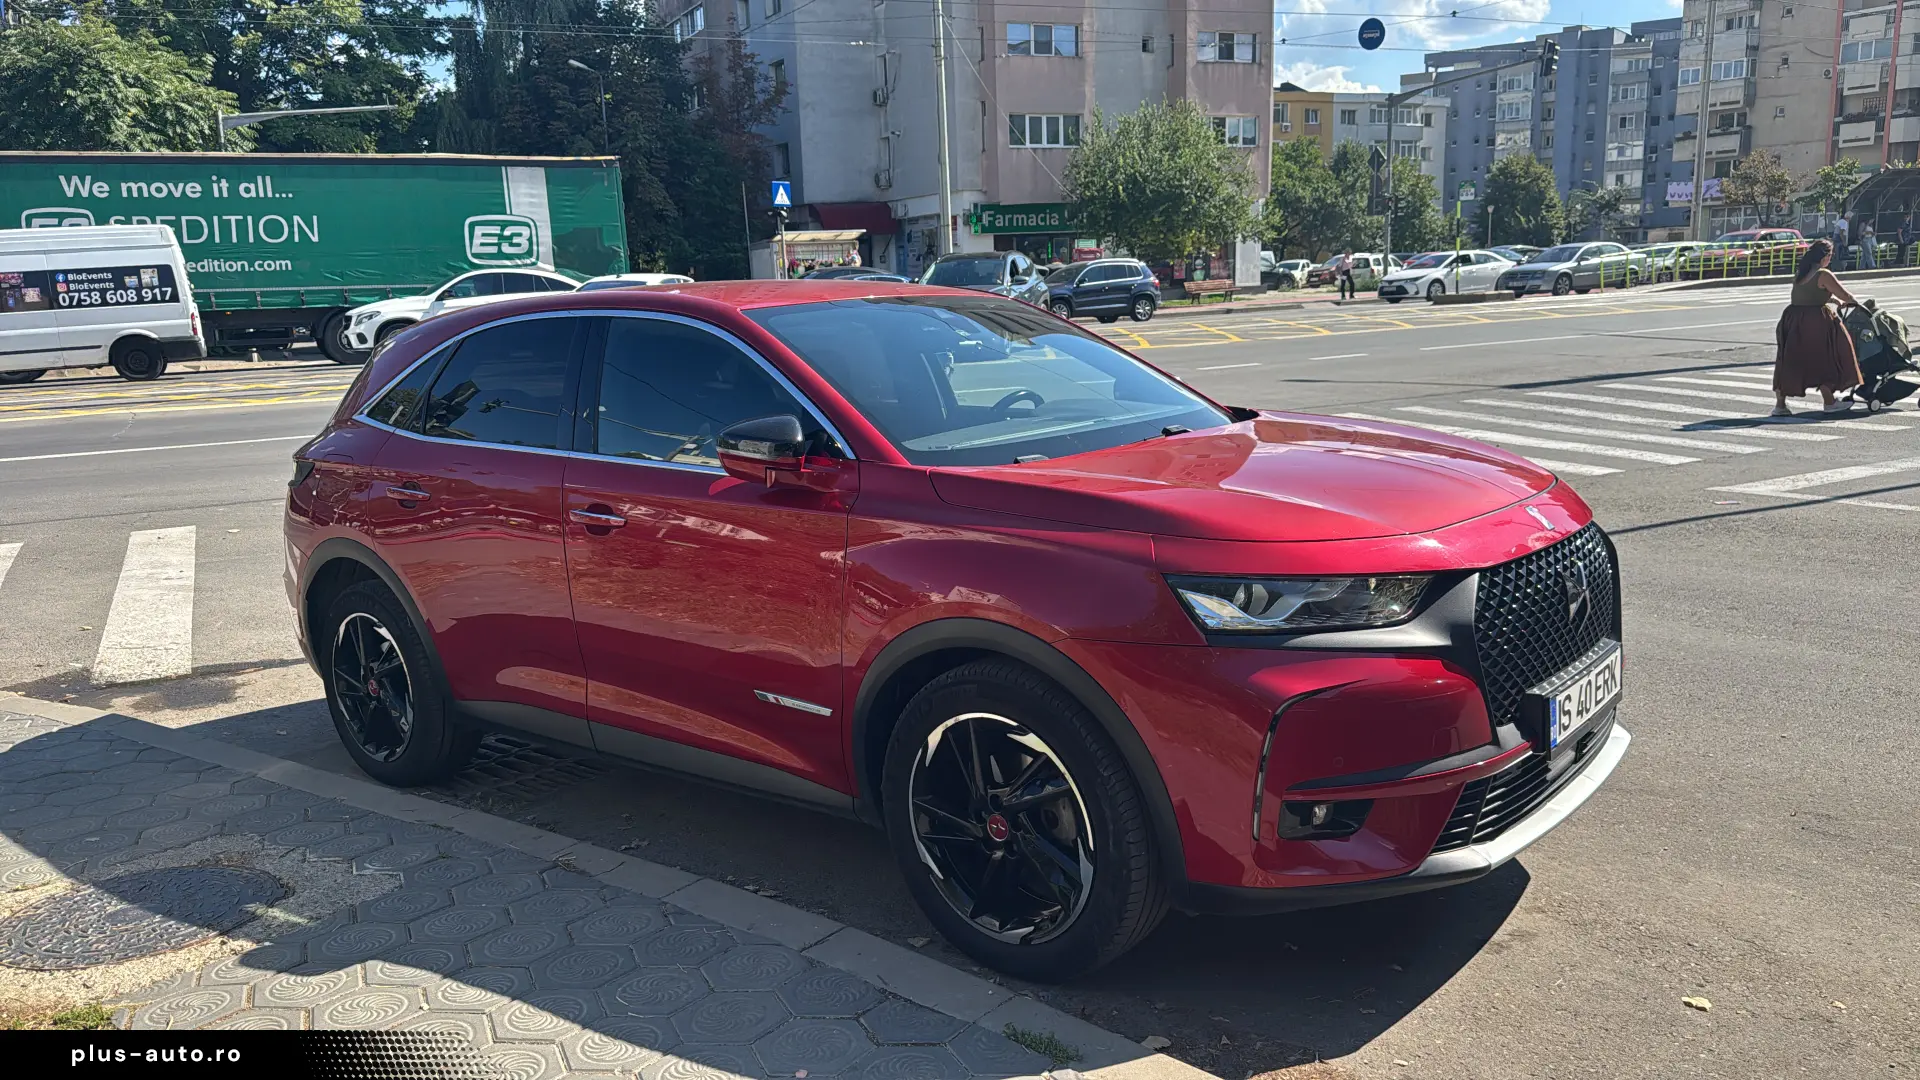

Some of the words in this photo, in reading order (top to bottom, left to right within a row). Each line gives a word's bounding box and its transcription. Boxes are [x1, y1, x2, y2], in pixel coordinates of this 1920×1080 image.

[58, 175, 110, 198] We
[120, 181, 202, 198] move
[212, 175, 229, 198] it
[238, 175, 293, 198] all...
[982, 210, 1059, 227] Farmacia
[471, 226, 531, 254] E3
[58, 291, 102, 306] 0758
[106, 289, 138, 304] 608
[141, 287, 172, 302] 917
[1558, 693, 1572, 736] IS
[1576, 678, 1592, 719] 40
[1595, 655, 1618, 708] ERK
